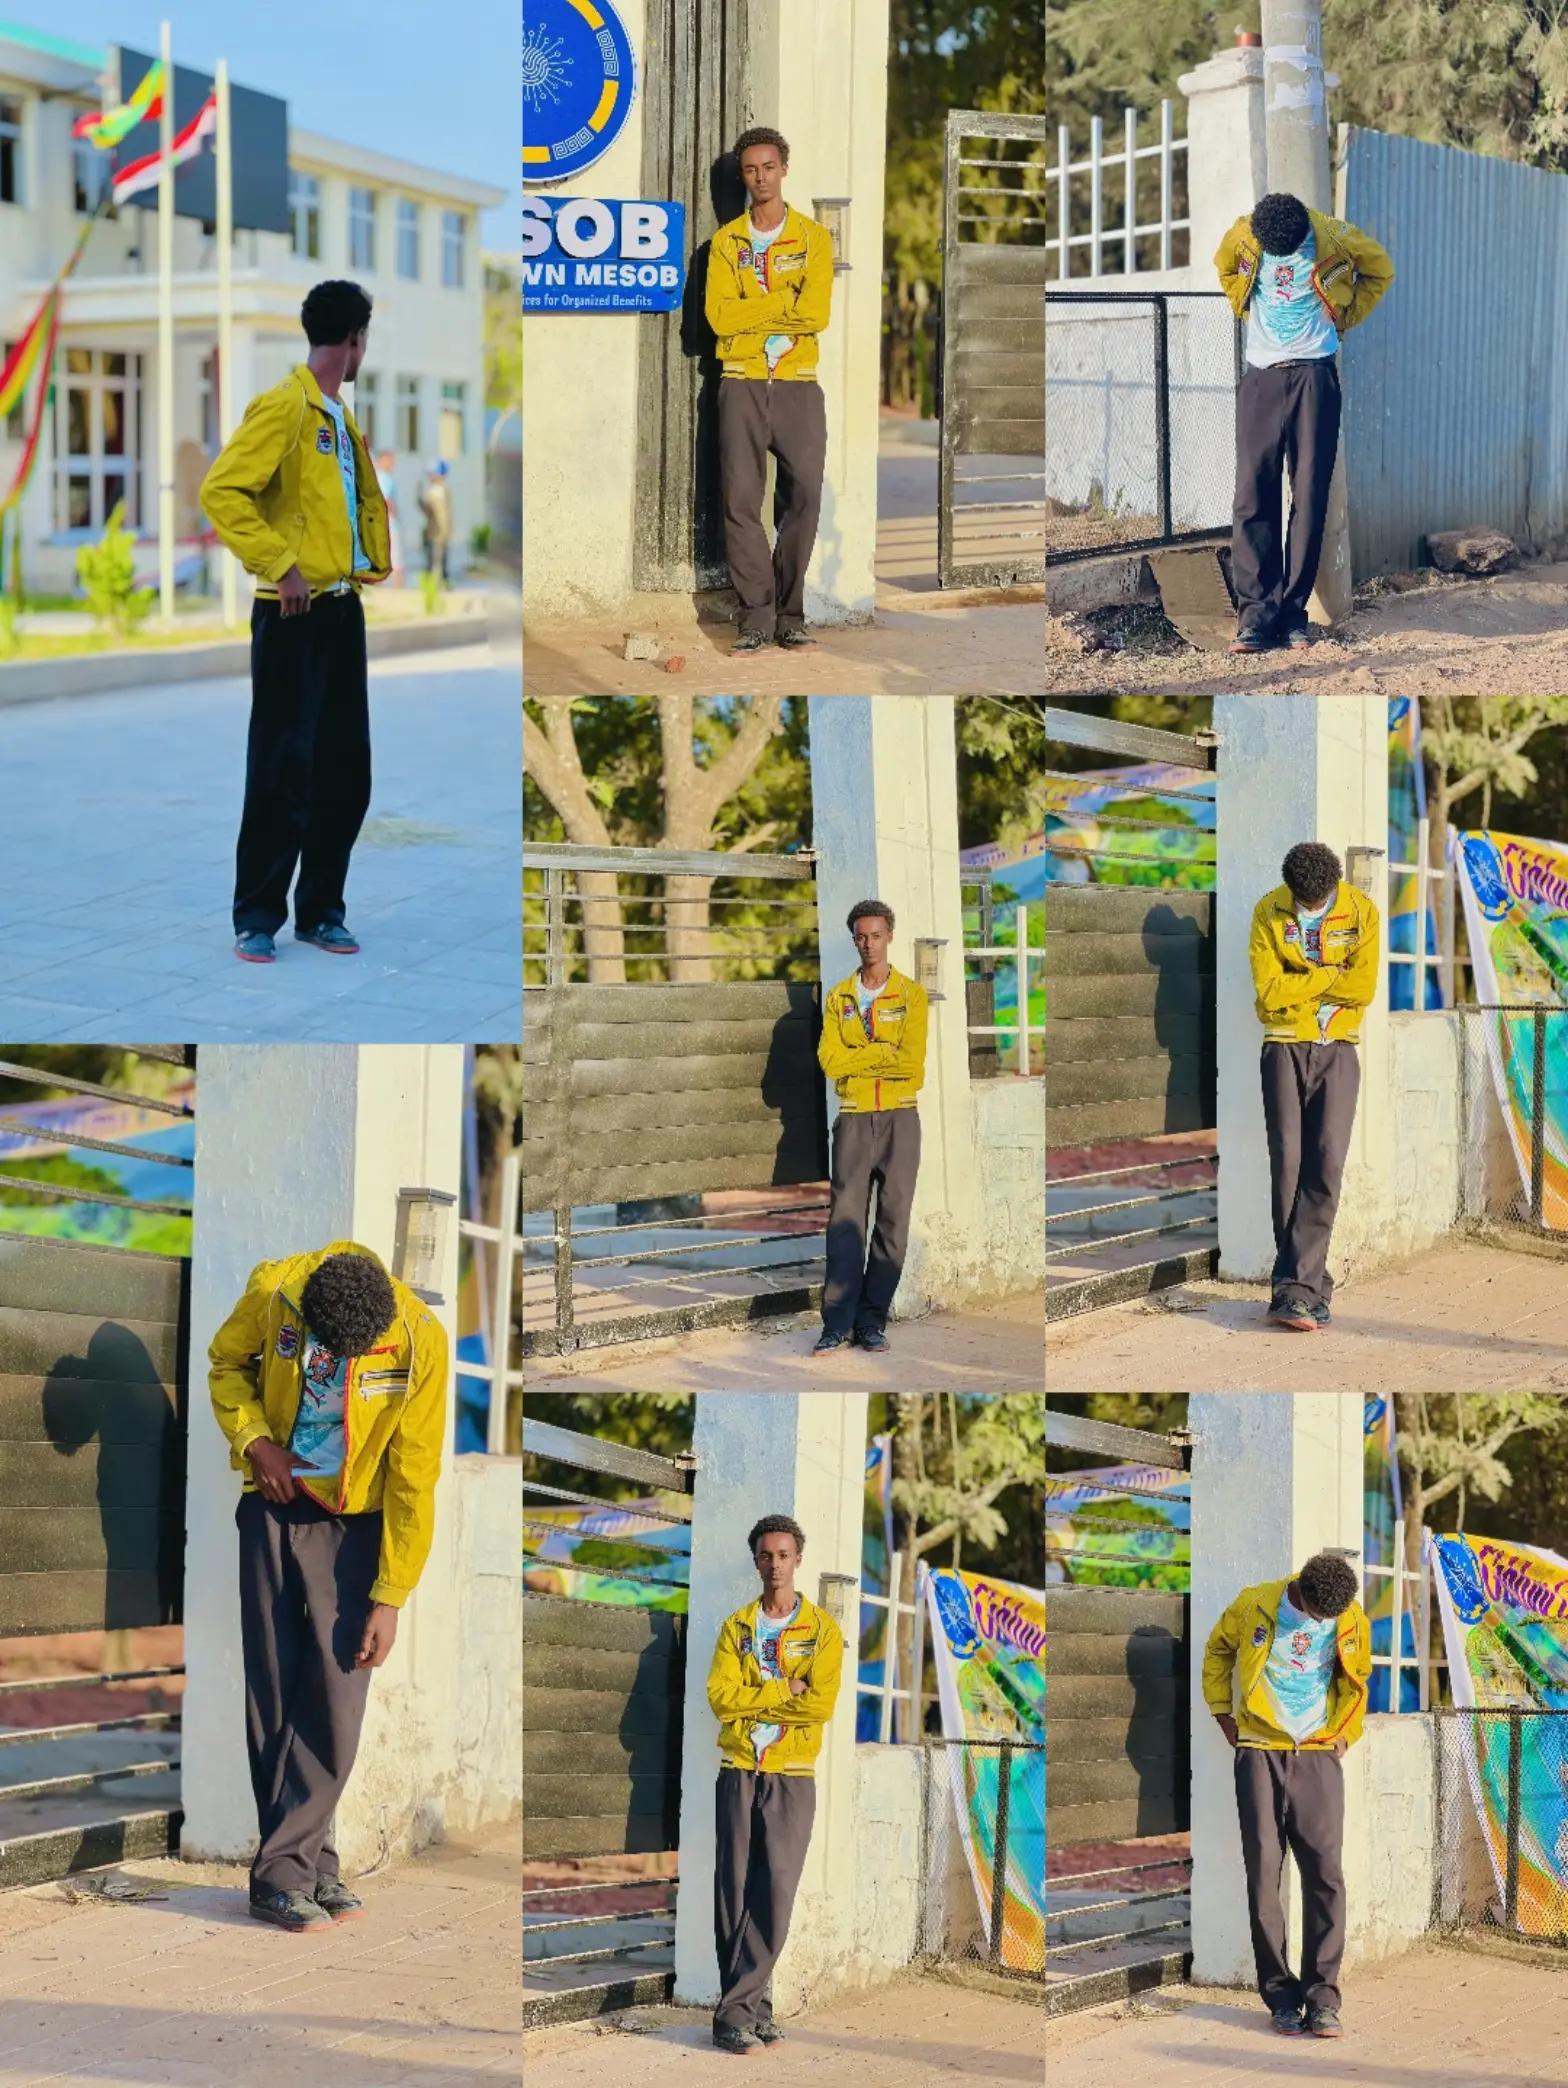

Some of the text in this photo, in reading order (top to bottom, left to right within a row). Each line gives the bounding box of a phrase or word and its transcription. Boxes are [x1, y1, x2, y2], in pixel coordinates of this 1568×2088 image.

[575, 263, 679, 287] MESOB
[544, 293, 559, 306] for
[561, 294, 609, 308] Organized
[612, 294, 653, 306] Benefits
